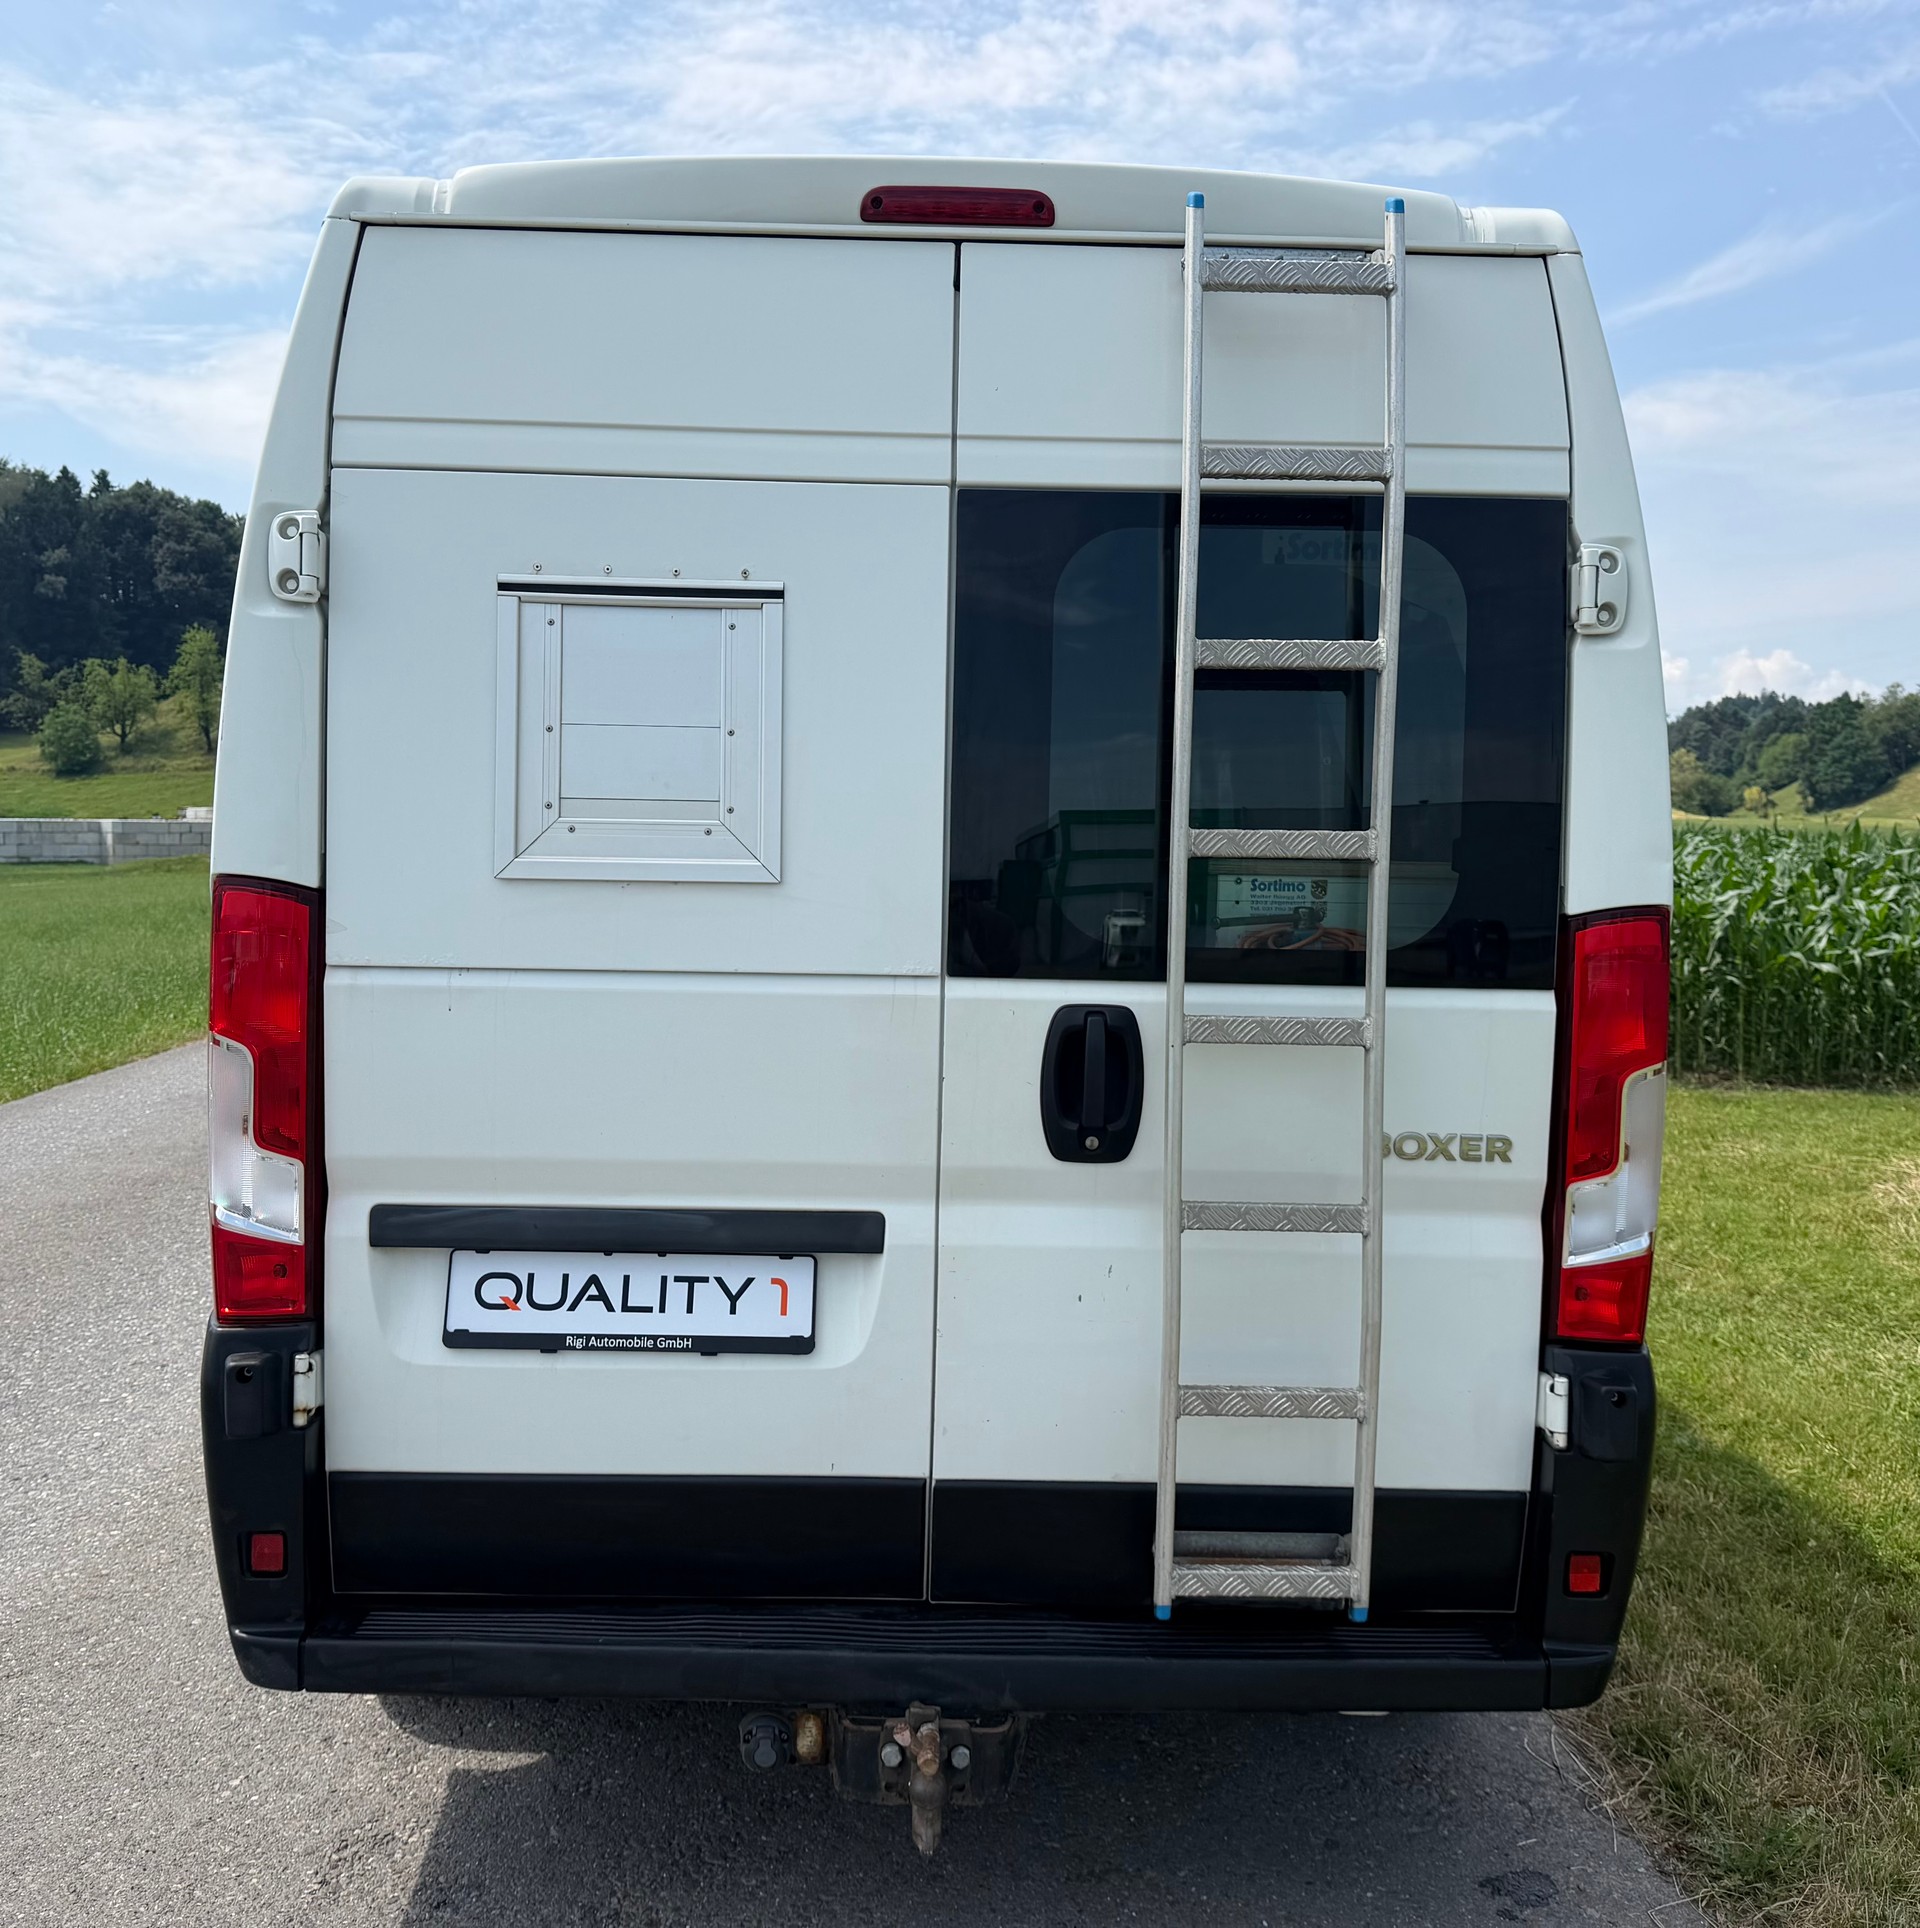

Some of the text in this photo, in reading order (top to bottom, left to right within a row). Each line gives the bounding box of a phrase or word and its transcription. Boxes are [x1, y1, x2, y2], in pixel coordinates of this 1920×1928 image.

[1287, 532, 1379, 561] Sortim
[1250, 878, 1306, 892] Sortimo
[474, 1271, 756, 1316] QUALITY
[565, 1335, 692, 1349] Rigi Automobile GmbH
